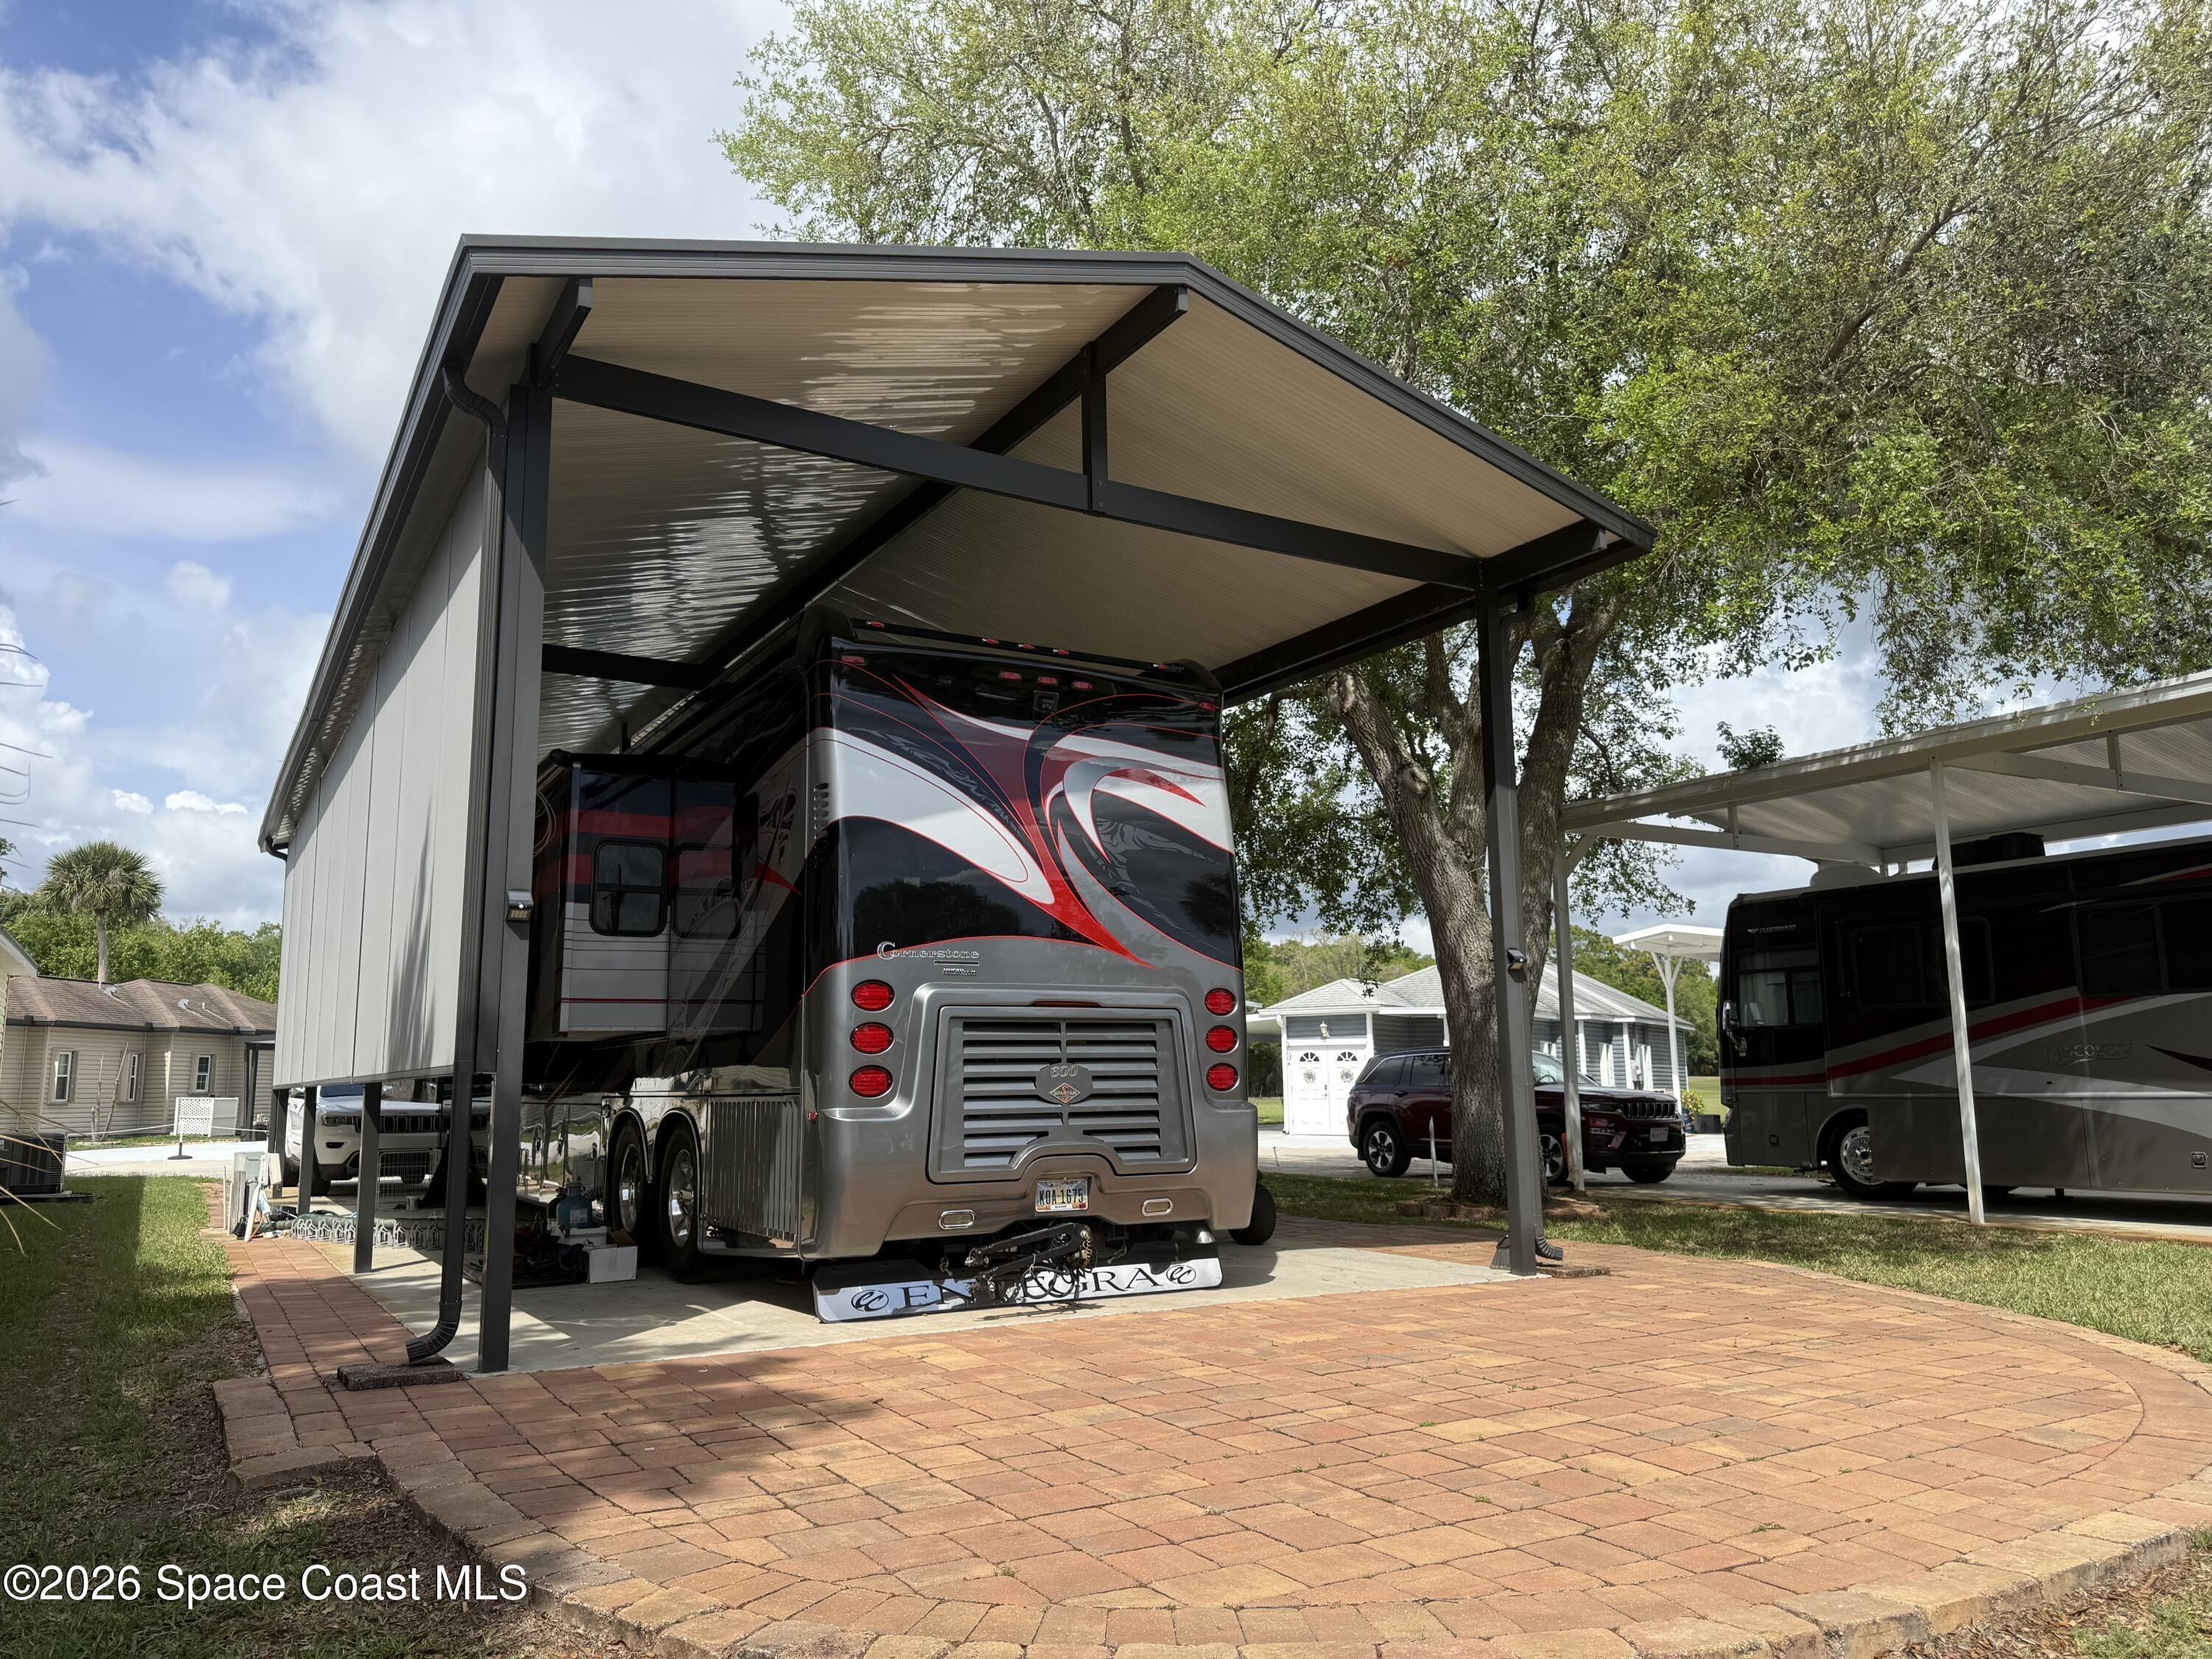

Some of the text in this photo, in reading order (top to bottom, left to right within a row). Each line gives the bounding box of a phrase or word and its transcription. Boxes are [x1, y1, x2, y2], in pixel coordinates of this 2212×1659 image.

[877, 941, 979, 959] Cornerstone
[1050, 1065, 1079, 1077] 600
[1060, 1188, 1083, 1204] 1675
